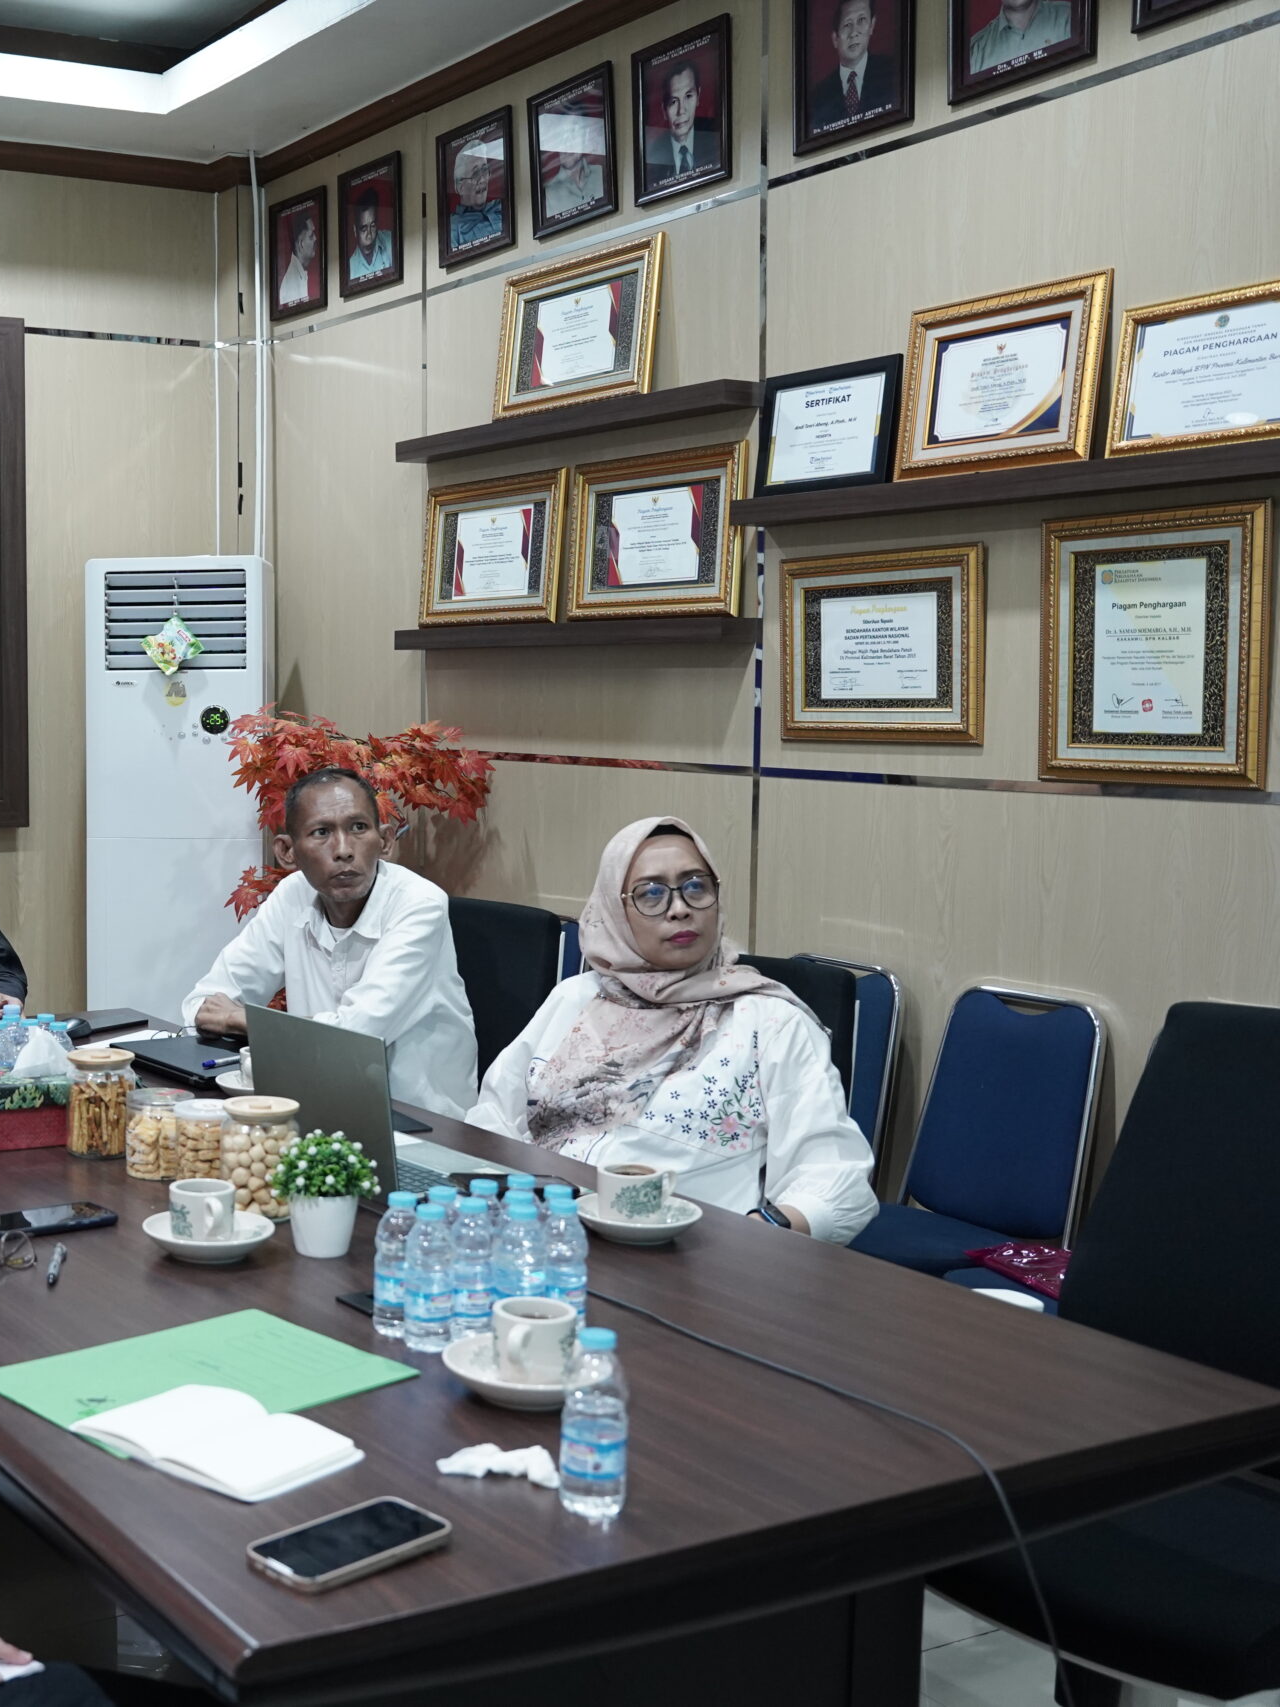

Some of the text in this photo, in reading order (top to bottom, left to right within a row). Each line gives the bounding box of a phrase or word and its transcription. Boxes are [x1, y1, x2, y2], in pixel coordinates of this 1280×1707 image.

[1163, 332, 1278, 358] PIAGAM PENGHARGAAN
[805, 394, 852, 409] SERTIFIKAT
[1112, 601, 1186, 611] Piagam Penghargaan
